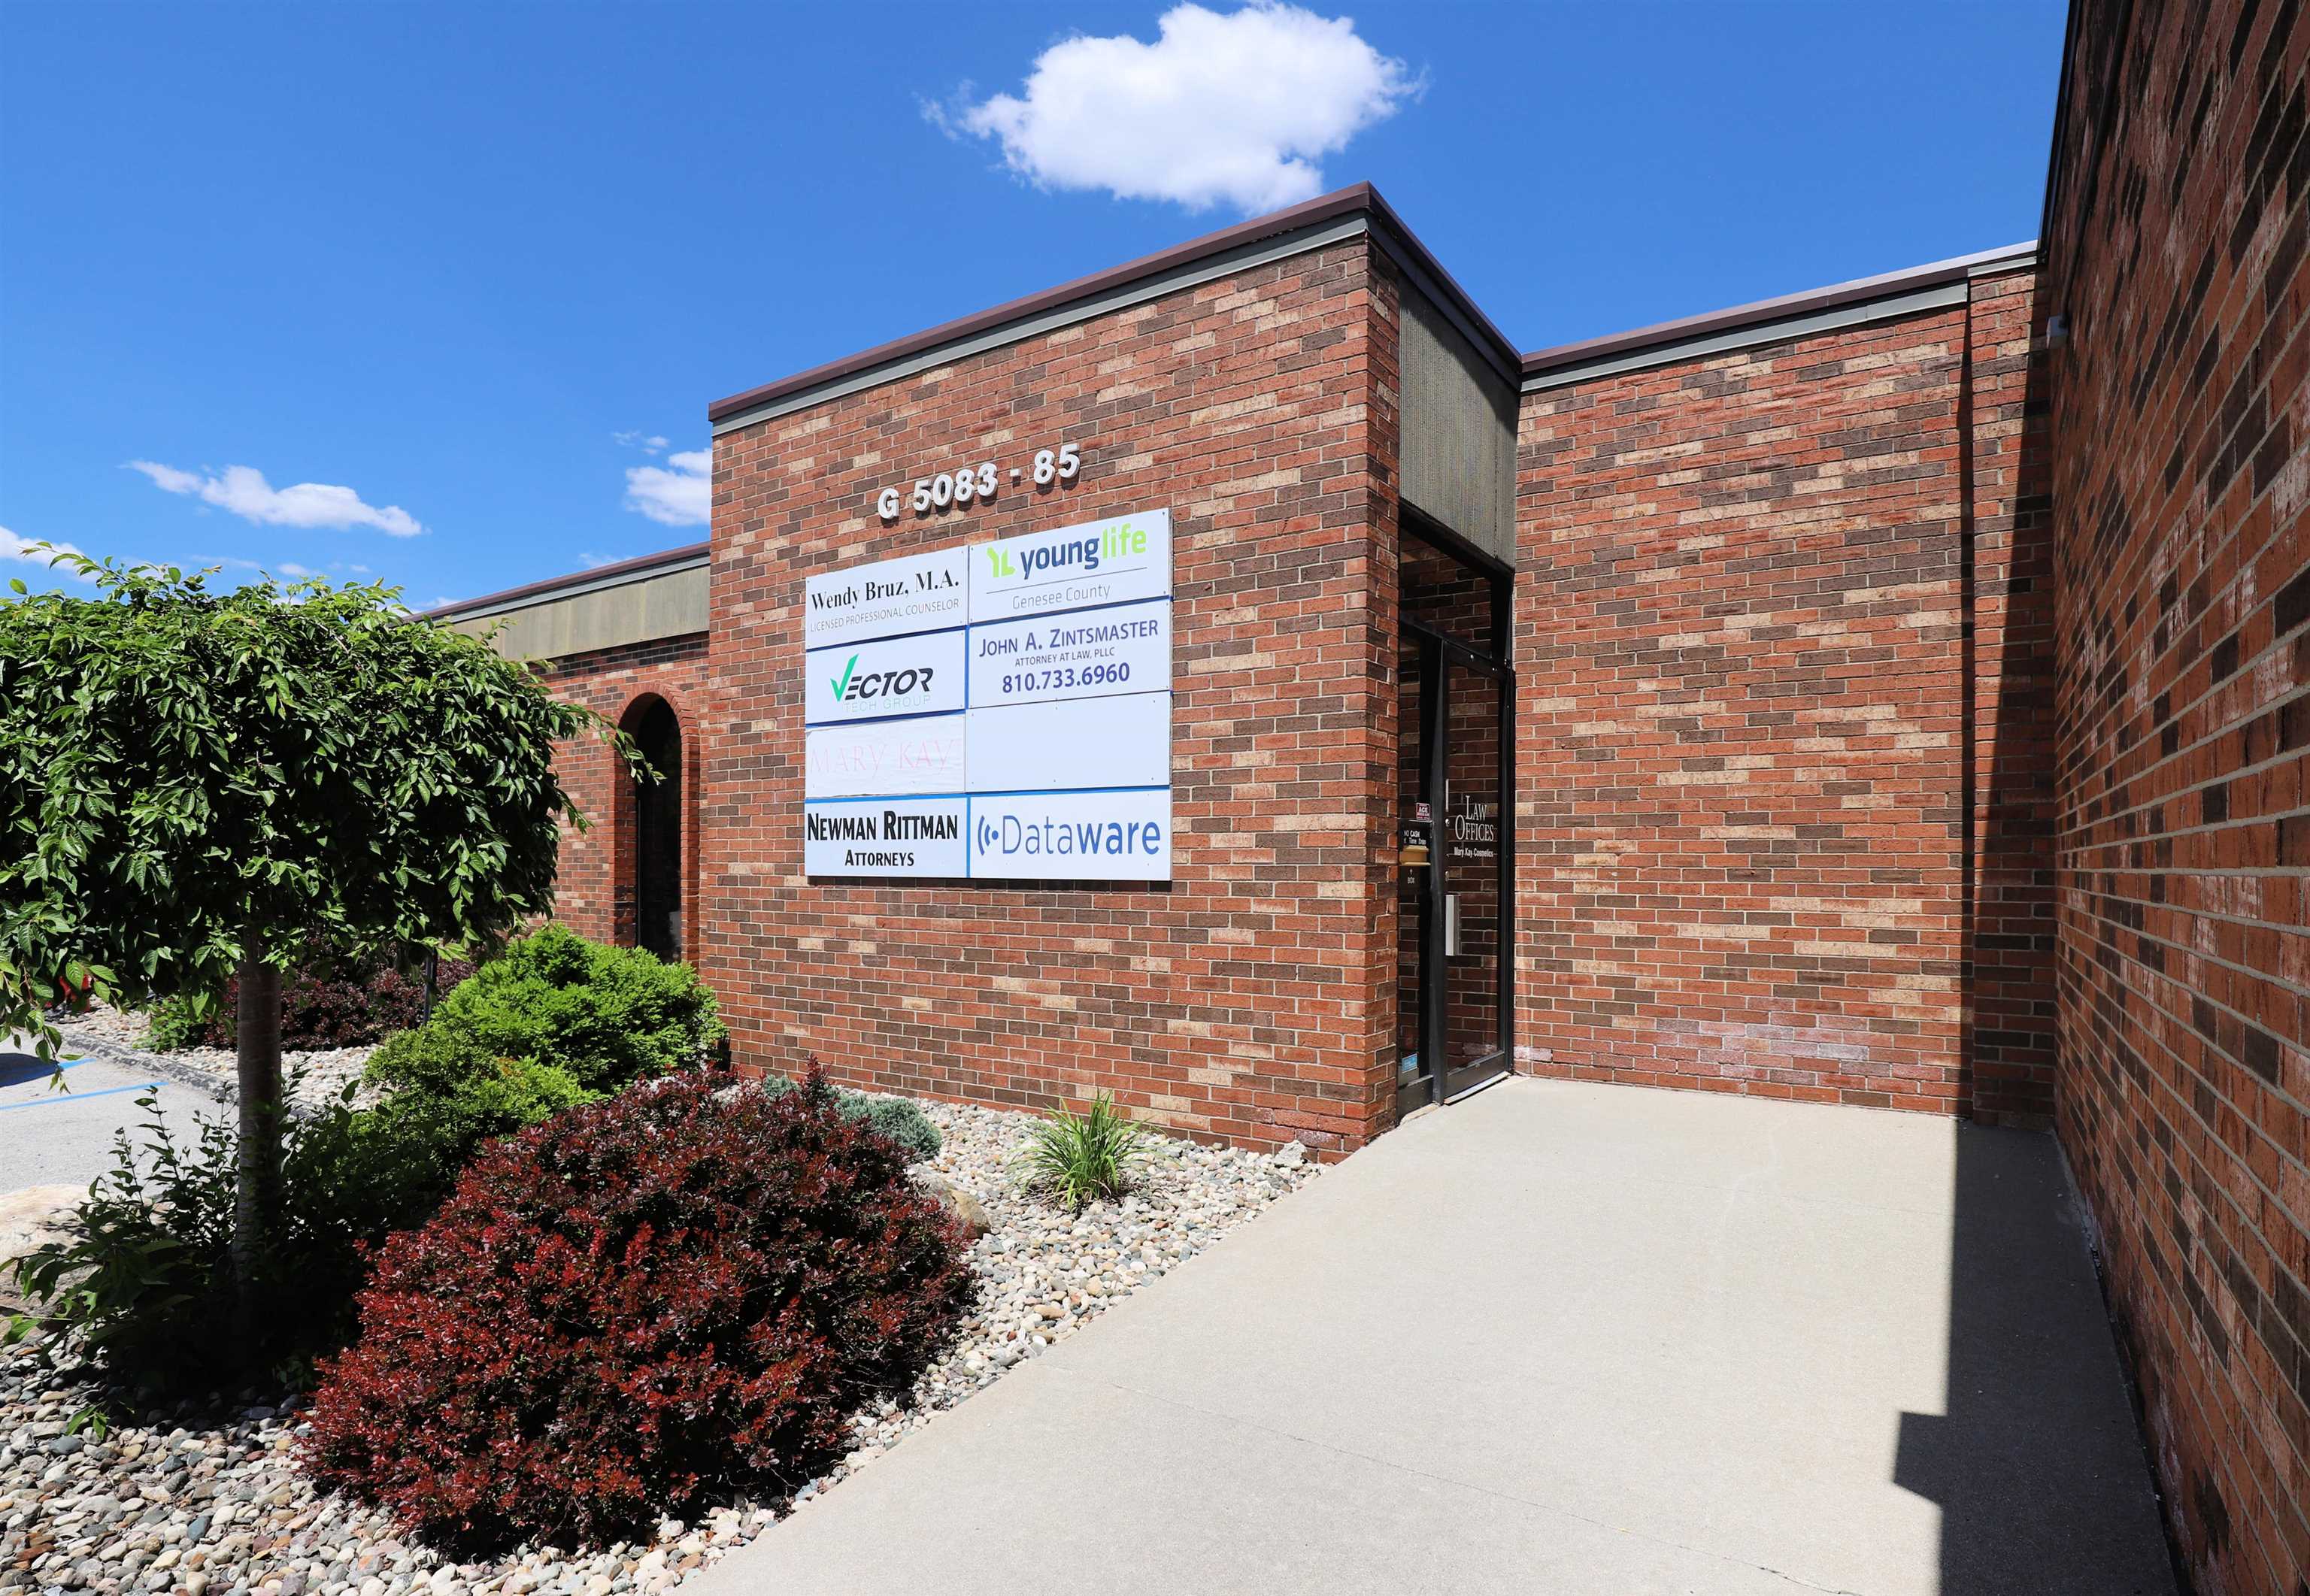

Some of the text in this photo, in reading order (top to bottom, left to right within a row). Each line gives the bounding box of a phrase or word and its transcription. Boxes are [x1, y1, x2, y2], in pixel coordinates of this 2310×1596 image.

[878, 488, 899, 519] G
[913, 463, 999, 511] 5083
[1033, 442, 1081, 484] 85
[811, 569, 959, 611] Wendy Bruz, M.A.
[1013, 583, 1111, 610] Genesee County
[811, 598, 959, 632] LICENSED PROFESSIONAL COUNSELOR
[979, 619, 1159, 657] JOHN A. ZINTSMASTER
[1015, 647, 1115, 668] ATTORNEY AT LAW, PLLC
[830, 653, 934, 702] VECTOR
[1002, 662, 1130, 693] 810.733.6960
[844, 695, 932, 713] TECH GROUP
[811, 738, 954, 777] MARY KAY
[1466, 795, 1487, 821] LAW
[808, 810, 958, 840] NEWMAN RITTMAN
[1002, 815, 1161, 855] Dataware
[1455, 814, 1494, 841] OFFICES
[844, 849, 914, 866] ATTORNEYS
[1454, 846, 1464, 858] Mary
[1474, 847, 1493, 858] Cosmetics
